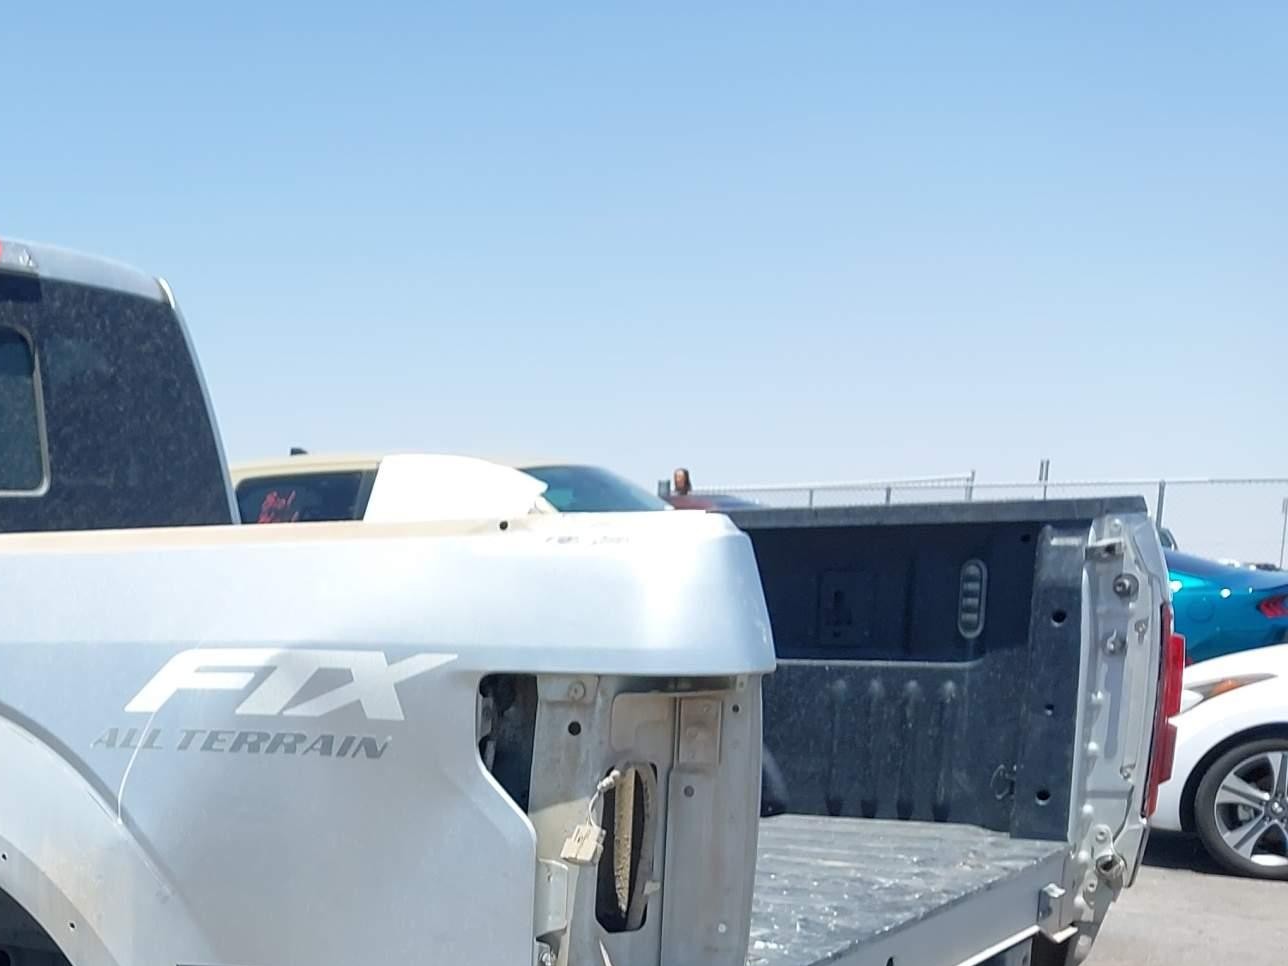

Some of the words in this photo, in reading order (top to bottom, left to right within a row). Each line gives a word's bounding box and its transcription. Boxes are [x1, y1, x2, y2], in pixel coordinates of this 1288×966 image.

[124, 647, 459, 721] FTX
[91, 726, 165, 750] ALL
[176, 728, 393, 760] TERRAIN
